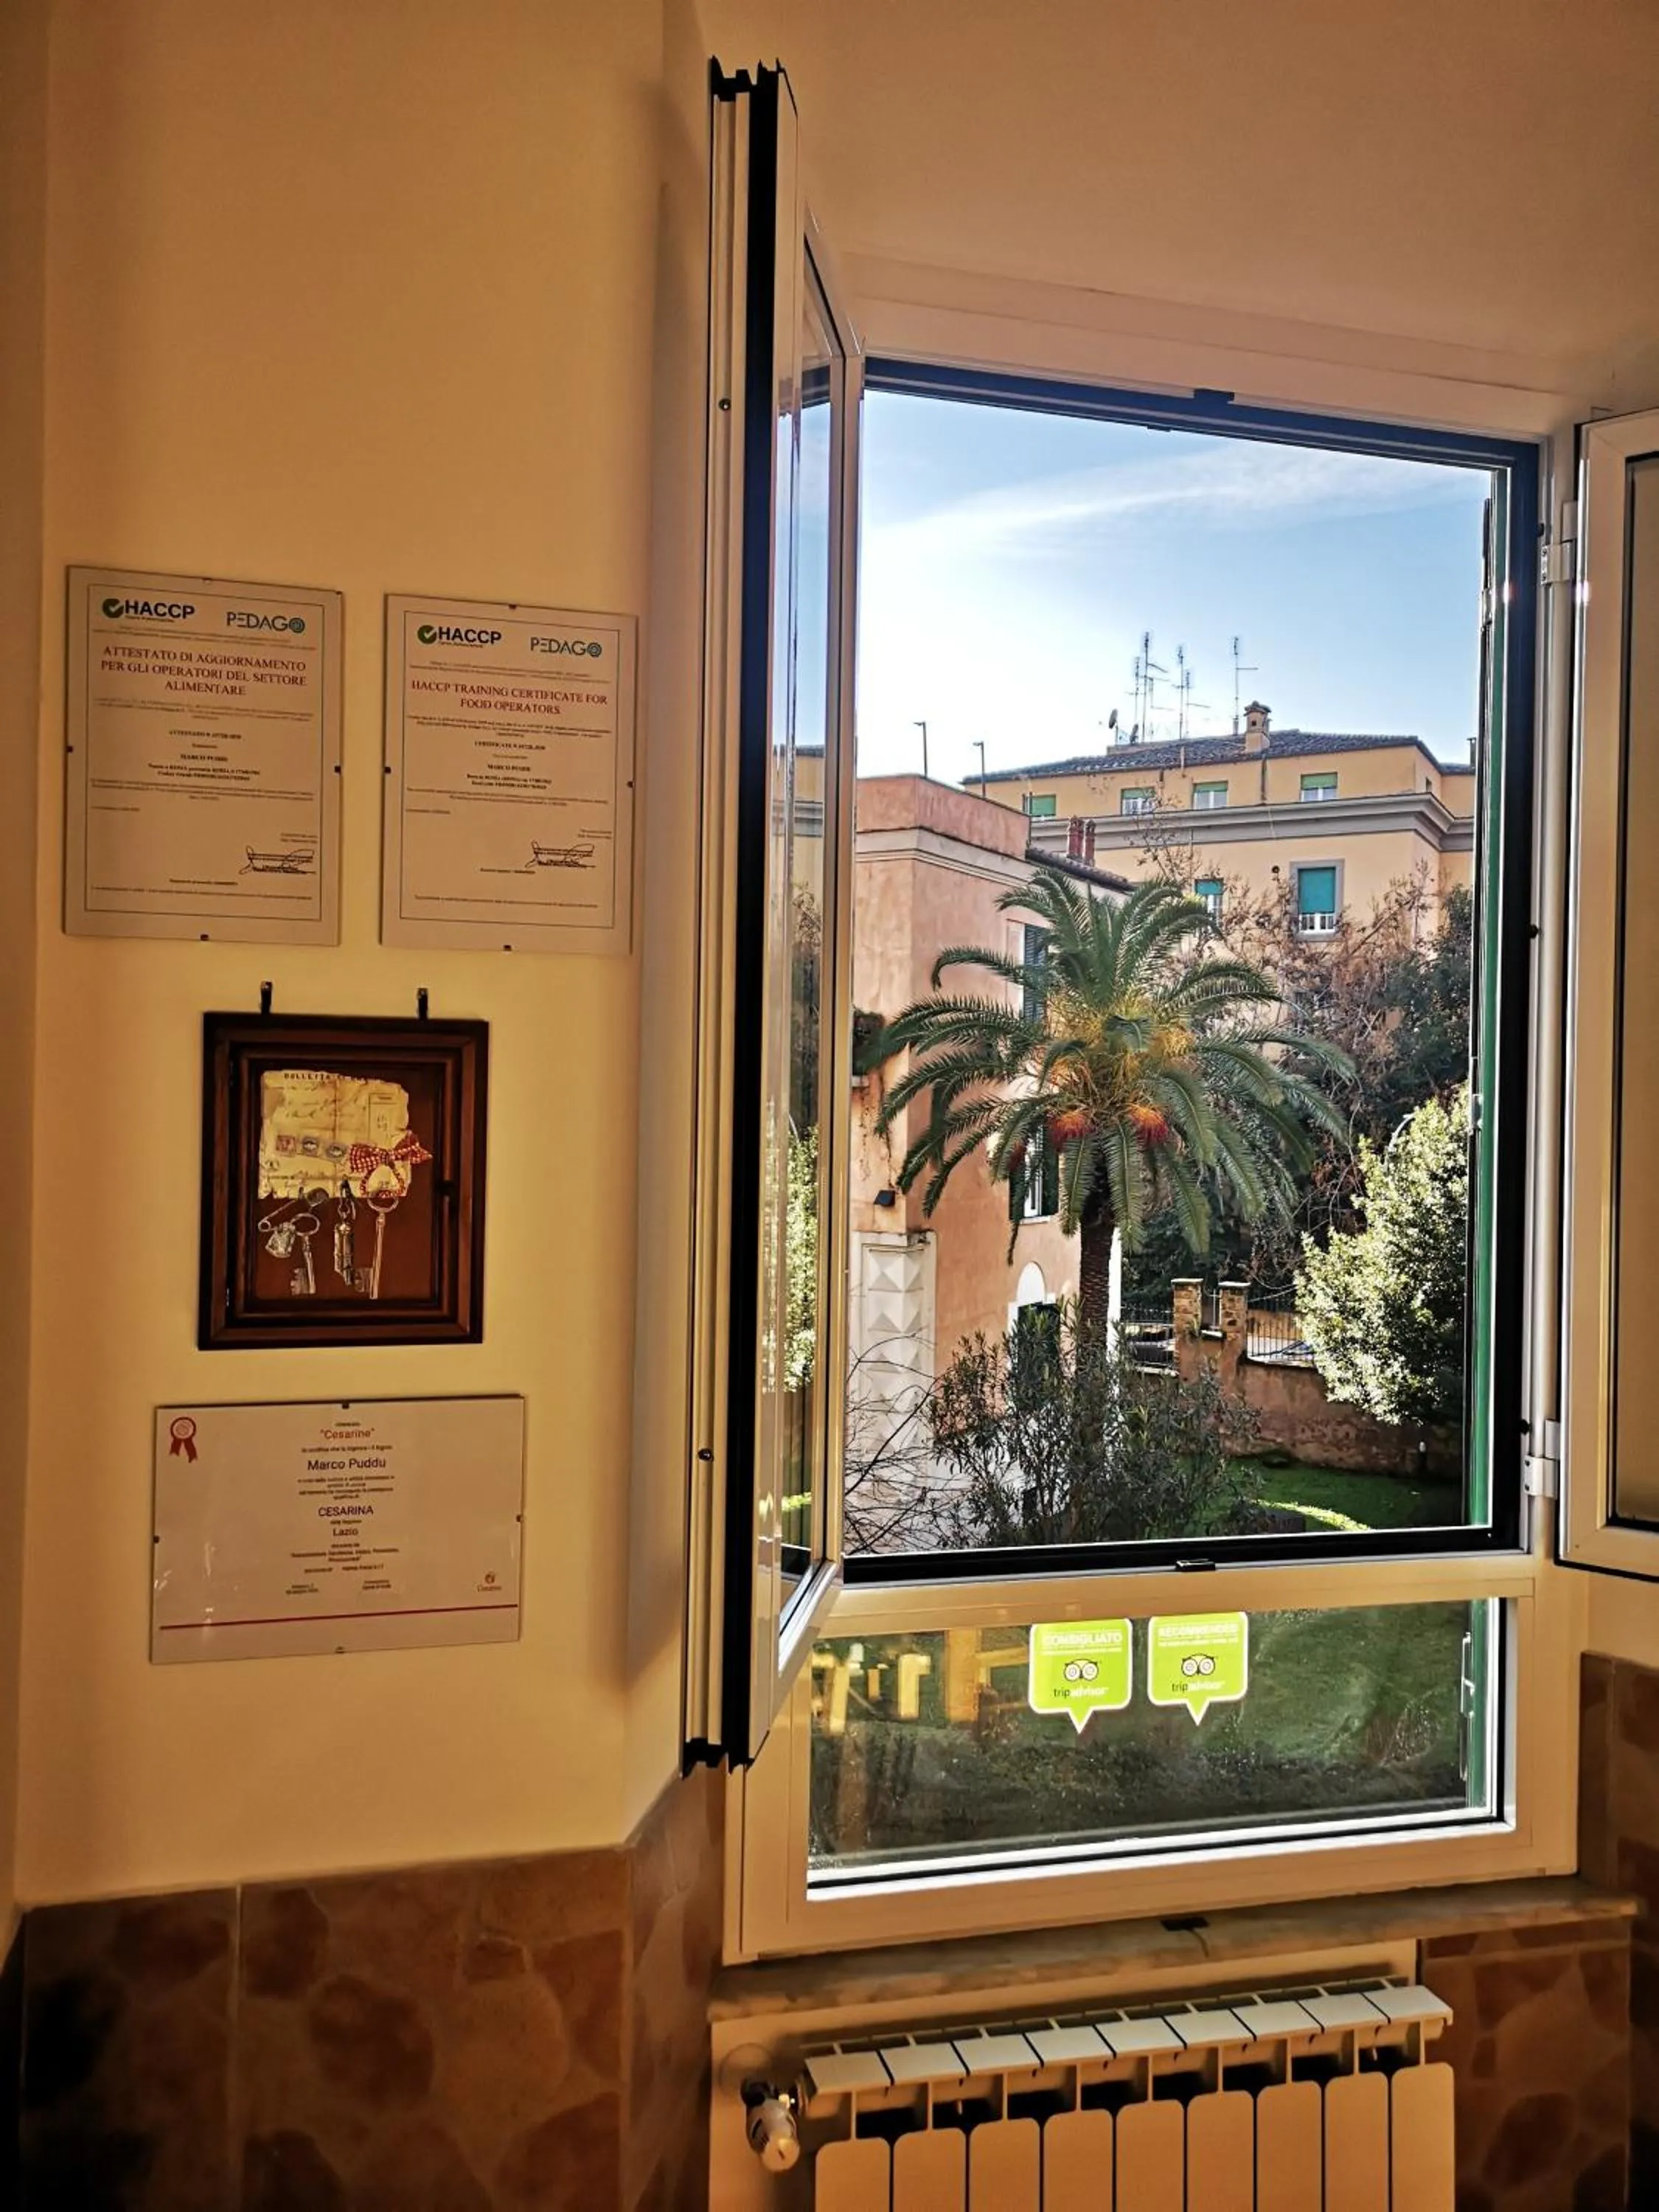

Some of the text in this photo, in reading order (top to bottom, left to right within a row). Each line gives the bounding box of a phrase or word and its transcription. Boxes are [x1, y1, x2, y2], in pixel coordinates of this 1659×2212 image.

[125, 599, 195, 619] HACCP
[226, 611, 306, 633] PEDAGO
[438, 626, 502, 644] HACCP
[530, 636, 602, 658] PEDAGO
[103, 646, 307, 672] ATTESTATO DI AGGIORNAMENTO
[101, 660, 307, 686] PER GLI OPERATORI DEL SETTORE
[164, 681, 246, 696] ALIMENTARE
[412, 680, 608, 705] HACCP TRAINING CERTIFICATE FOR
[460, 698, 561, 714] FOOD OPERATORS
[307, 1457, 386, 1470] Marco Puddu
[318, 1505, 375, 1517] CESARINA
[333, 1527, 359, 1537] Lazio
